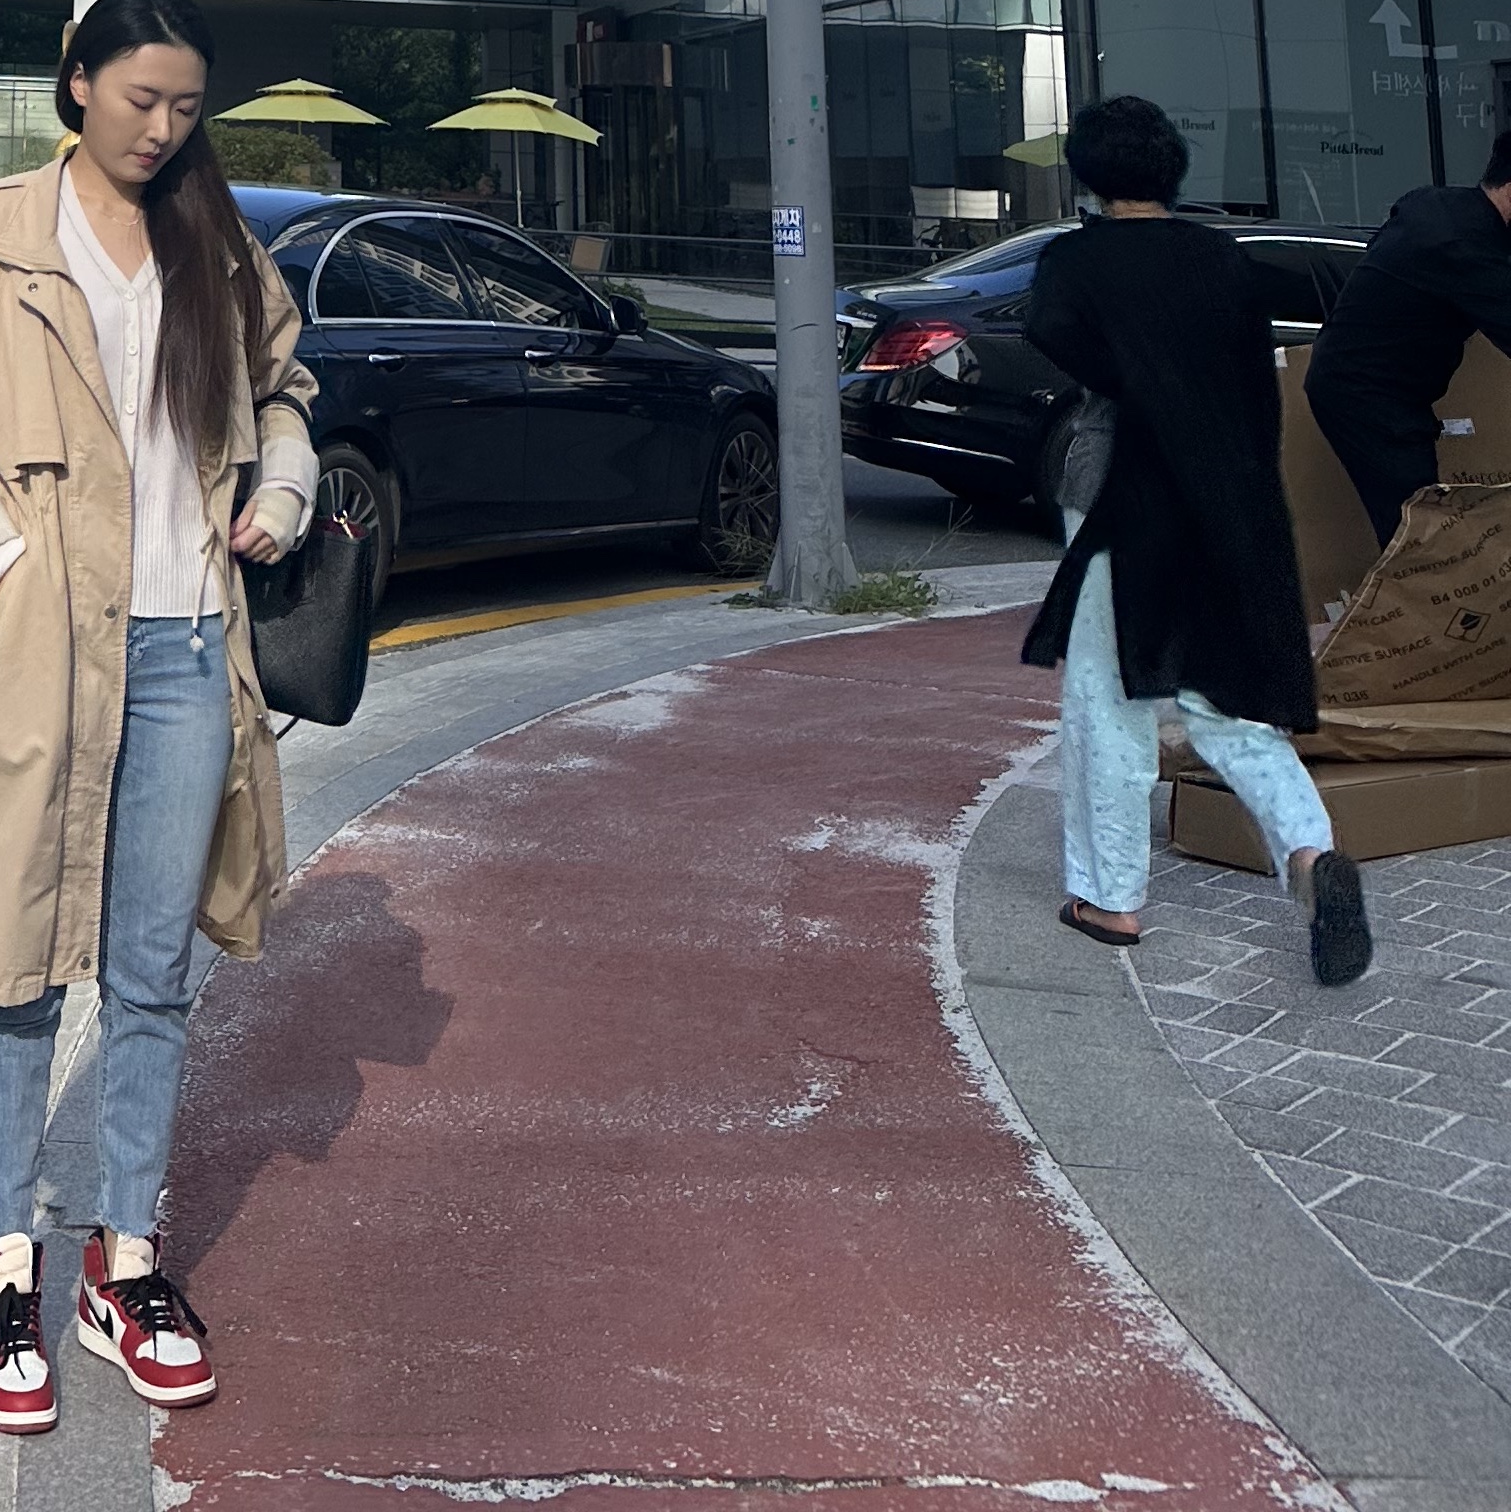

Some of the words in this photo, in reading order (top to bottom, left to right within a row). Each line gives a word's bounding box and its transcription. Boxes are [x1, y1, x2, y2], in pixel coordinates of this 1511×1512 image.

[773, 229, 801, 244] -0448
[1371, 606, 1405, 625] CARE
[1374, 635, 1432, 662] SURFACE
[1392, 666, 1441, 690] HANDLE
[1444, 653, 1474, 670] WITH
[1475, 637, 1507, 656] CARE
